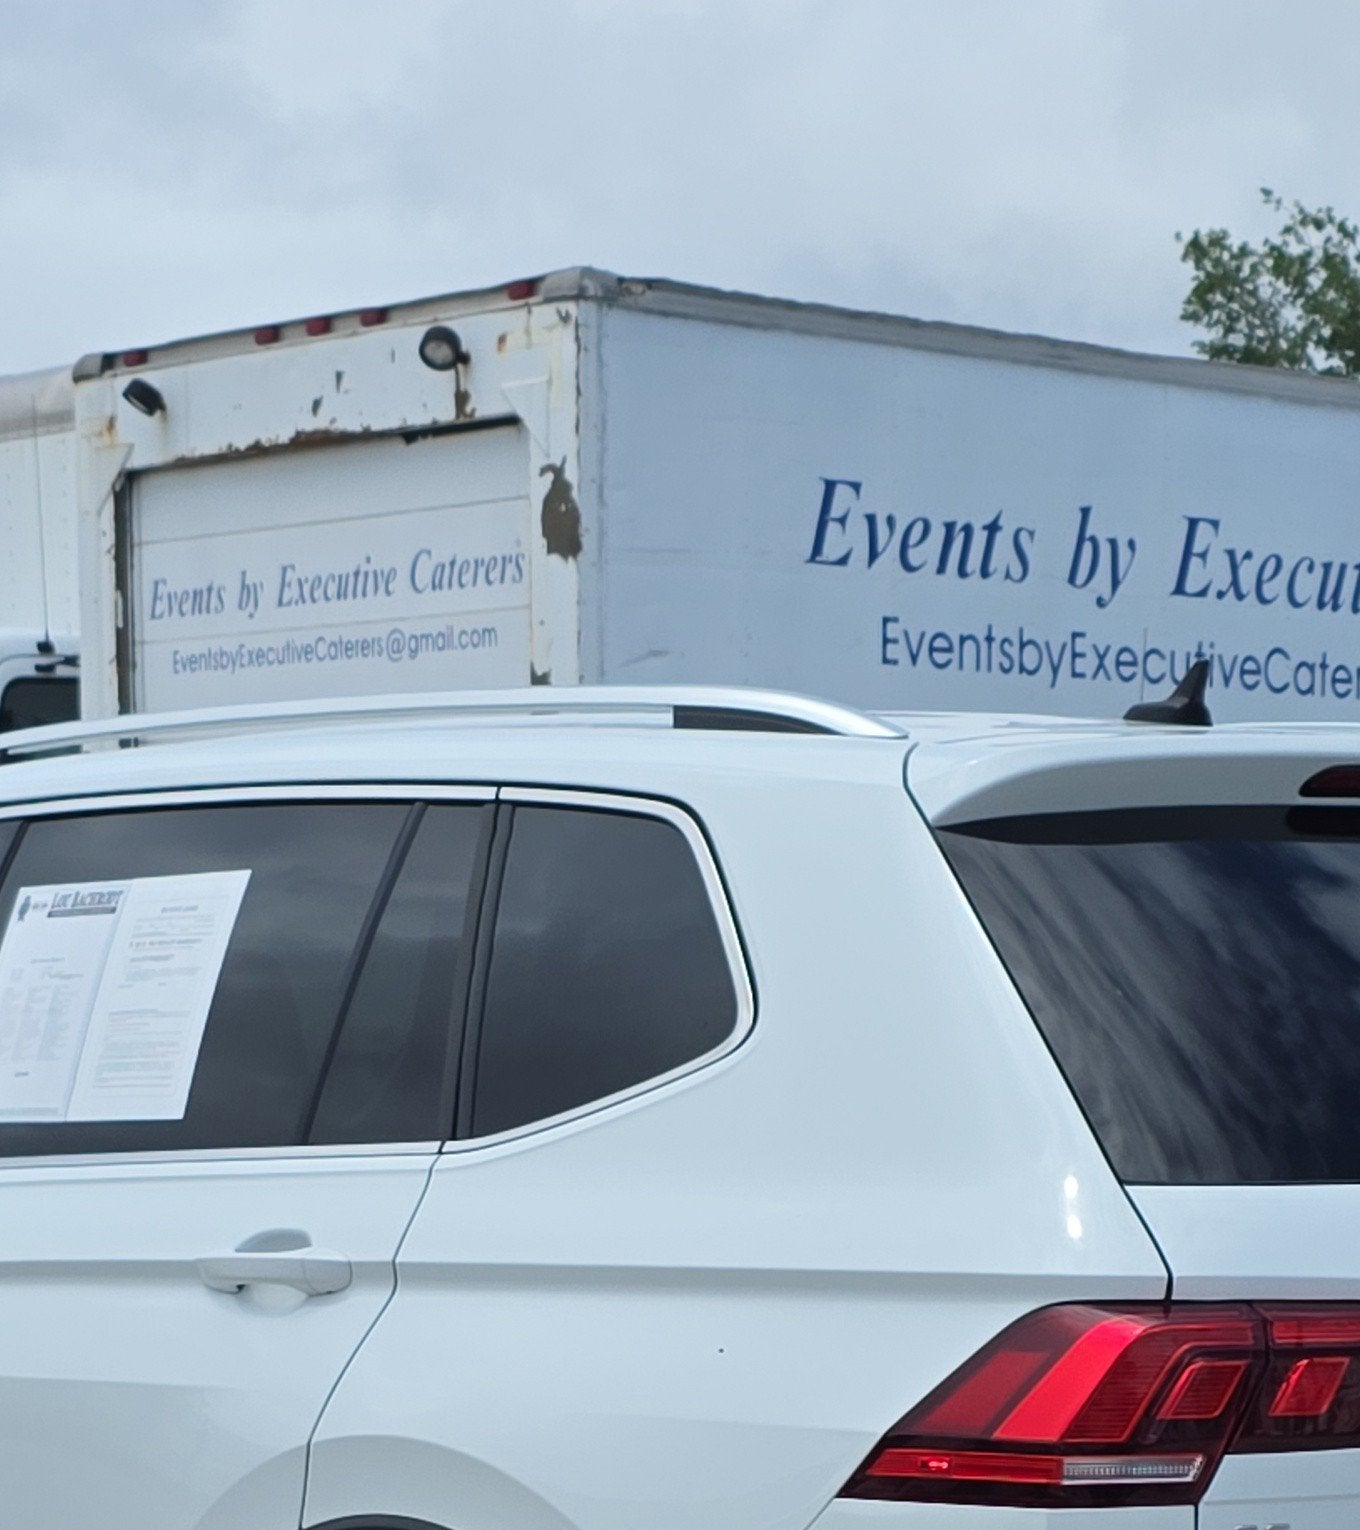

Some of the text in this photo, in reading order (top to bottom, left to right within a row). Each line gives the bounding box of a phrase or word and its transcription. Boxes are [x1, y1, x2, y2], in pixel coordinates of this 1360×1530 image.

[804, 477, 1036, 584] Events
[1067, 505, 1136, 609] by
[149, 549, 525, 621] Events by Executive Caterers
[172, 625, 498, 675] EventsbyExecutiveCaterers@gmail.com
